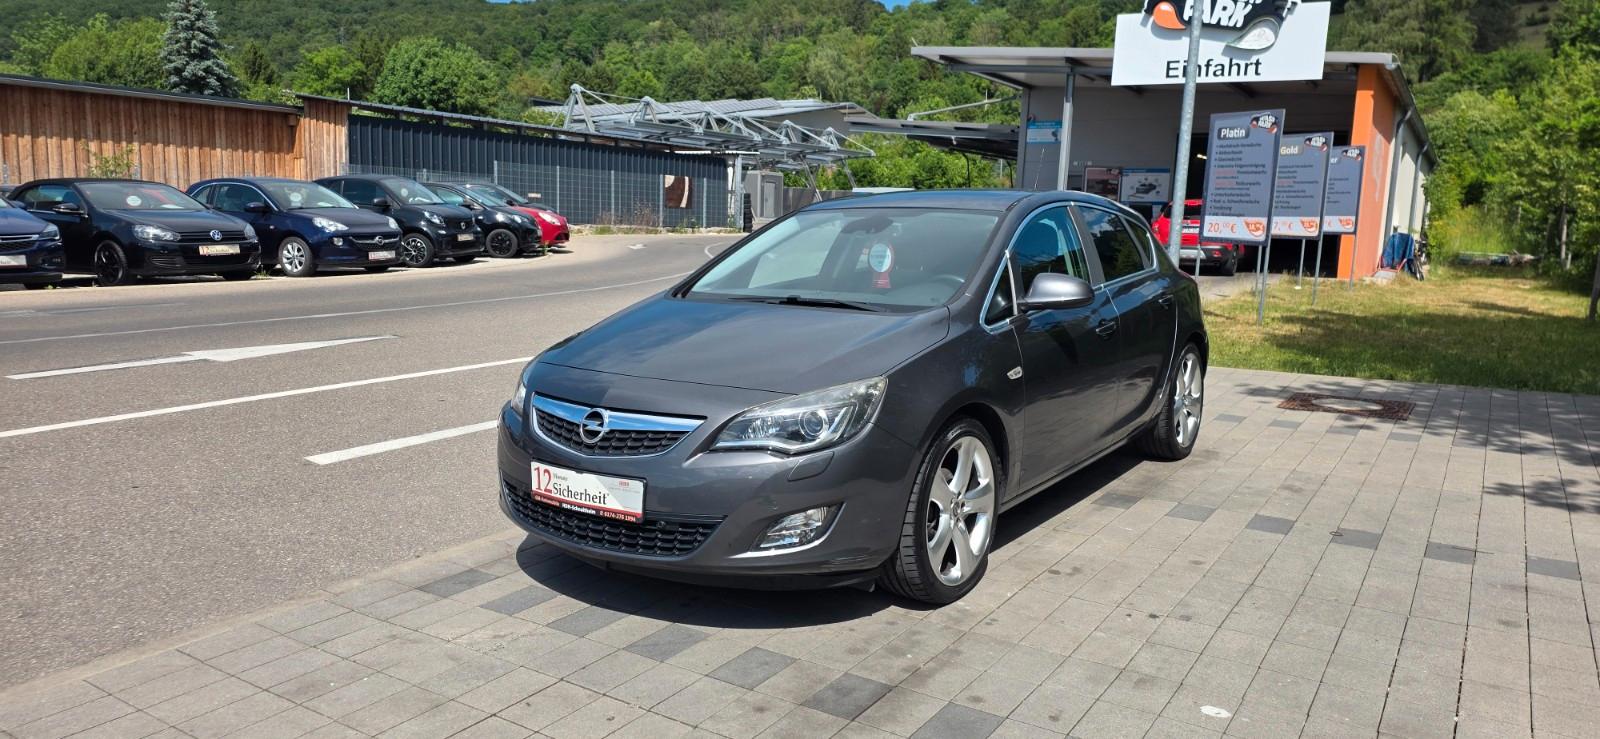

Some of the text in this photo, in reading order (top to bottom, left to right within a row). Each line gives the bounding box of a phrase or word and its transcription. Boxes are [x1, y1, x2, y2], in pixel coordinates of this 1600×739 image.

[1220, 127, 1246, 138] Platin
[1280, 146, 1298, 155] Gold
[534, 466, 552, 494] 12
